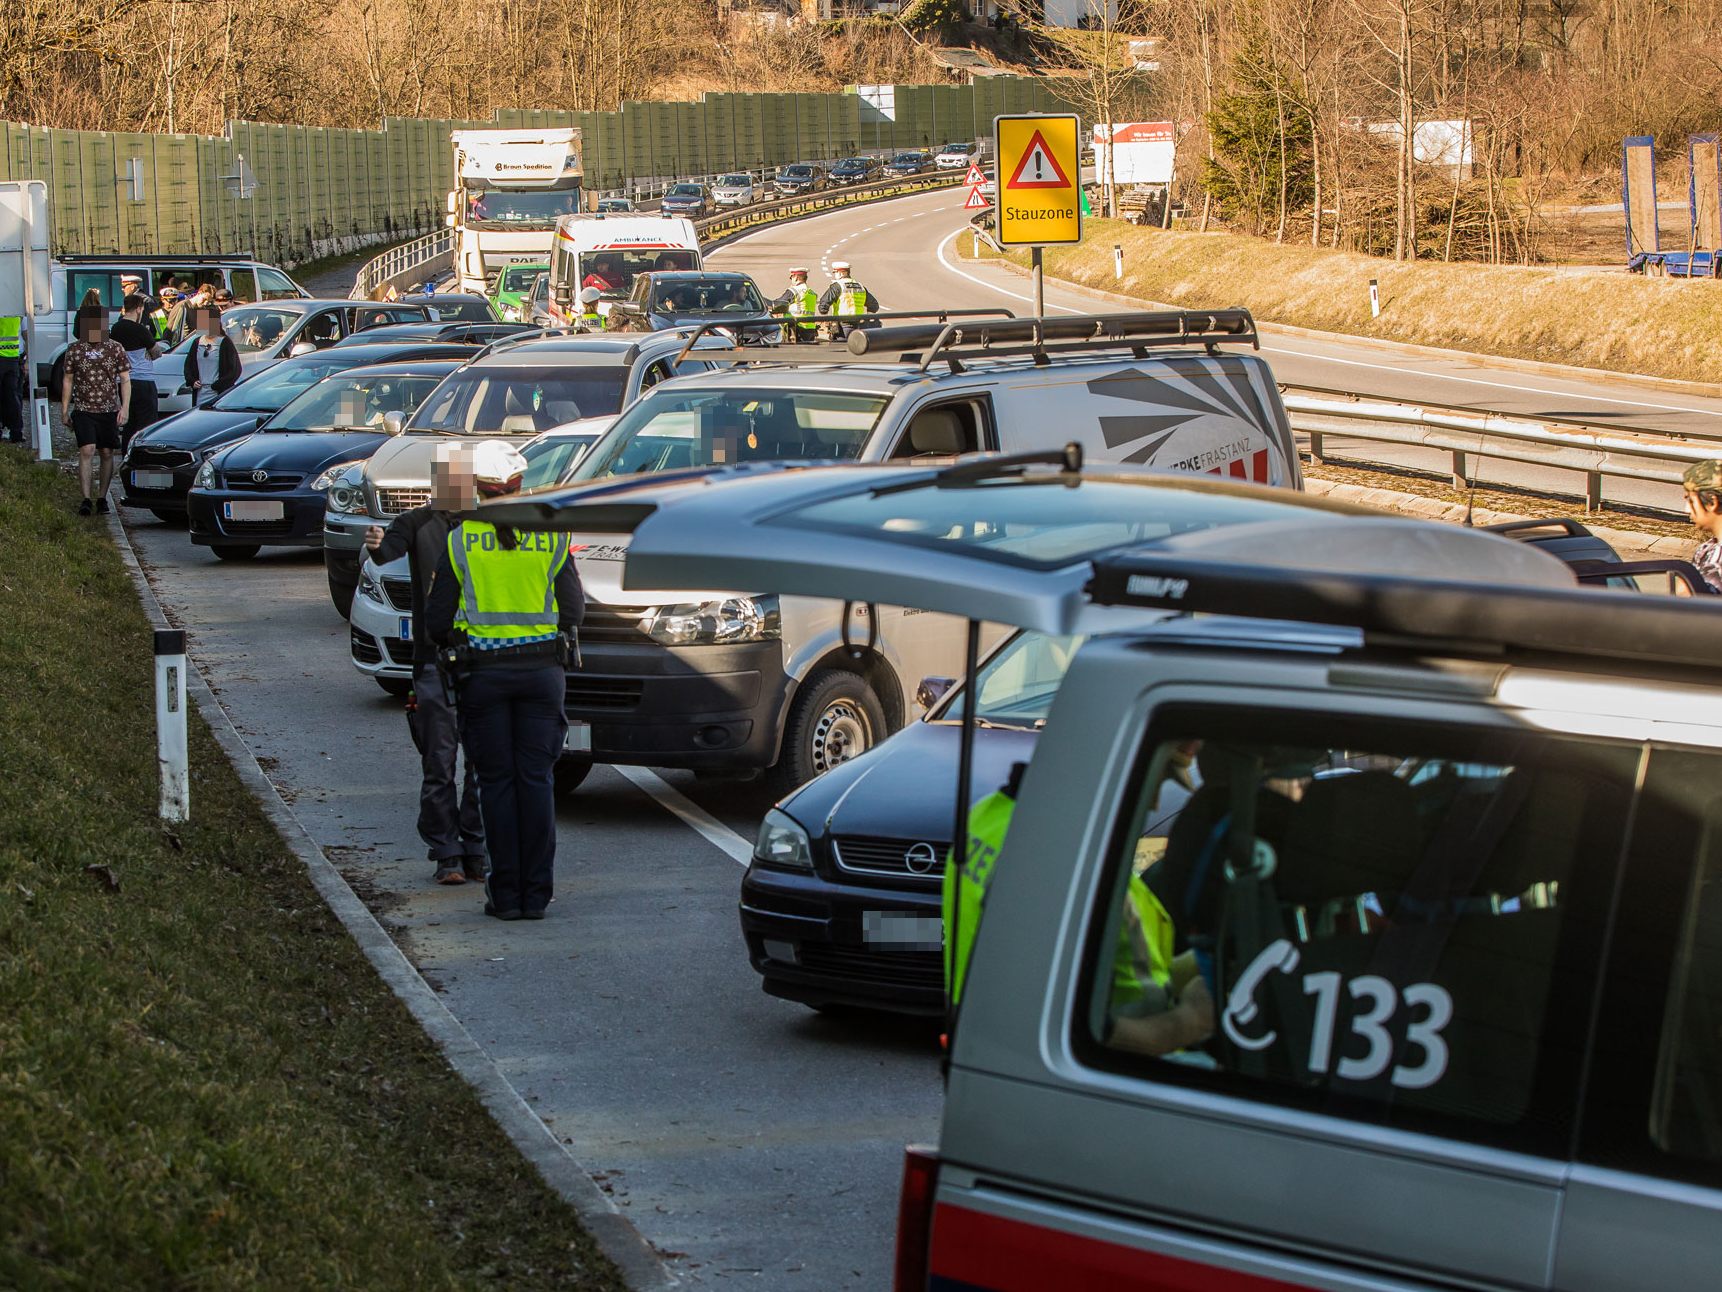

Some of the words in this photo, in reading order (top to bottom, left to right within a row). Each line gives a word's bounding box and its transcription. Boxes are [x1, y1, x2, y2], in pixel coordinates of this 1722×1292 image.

[1006, 207, 1074, 221] Stauzone
[465, 531, 555, 553] POZEI
[1302, 970, 1454, 1090] 133
